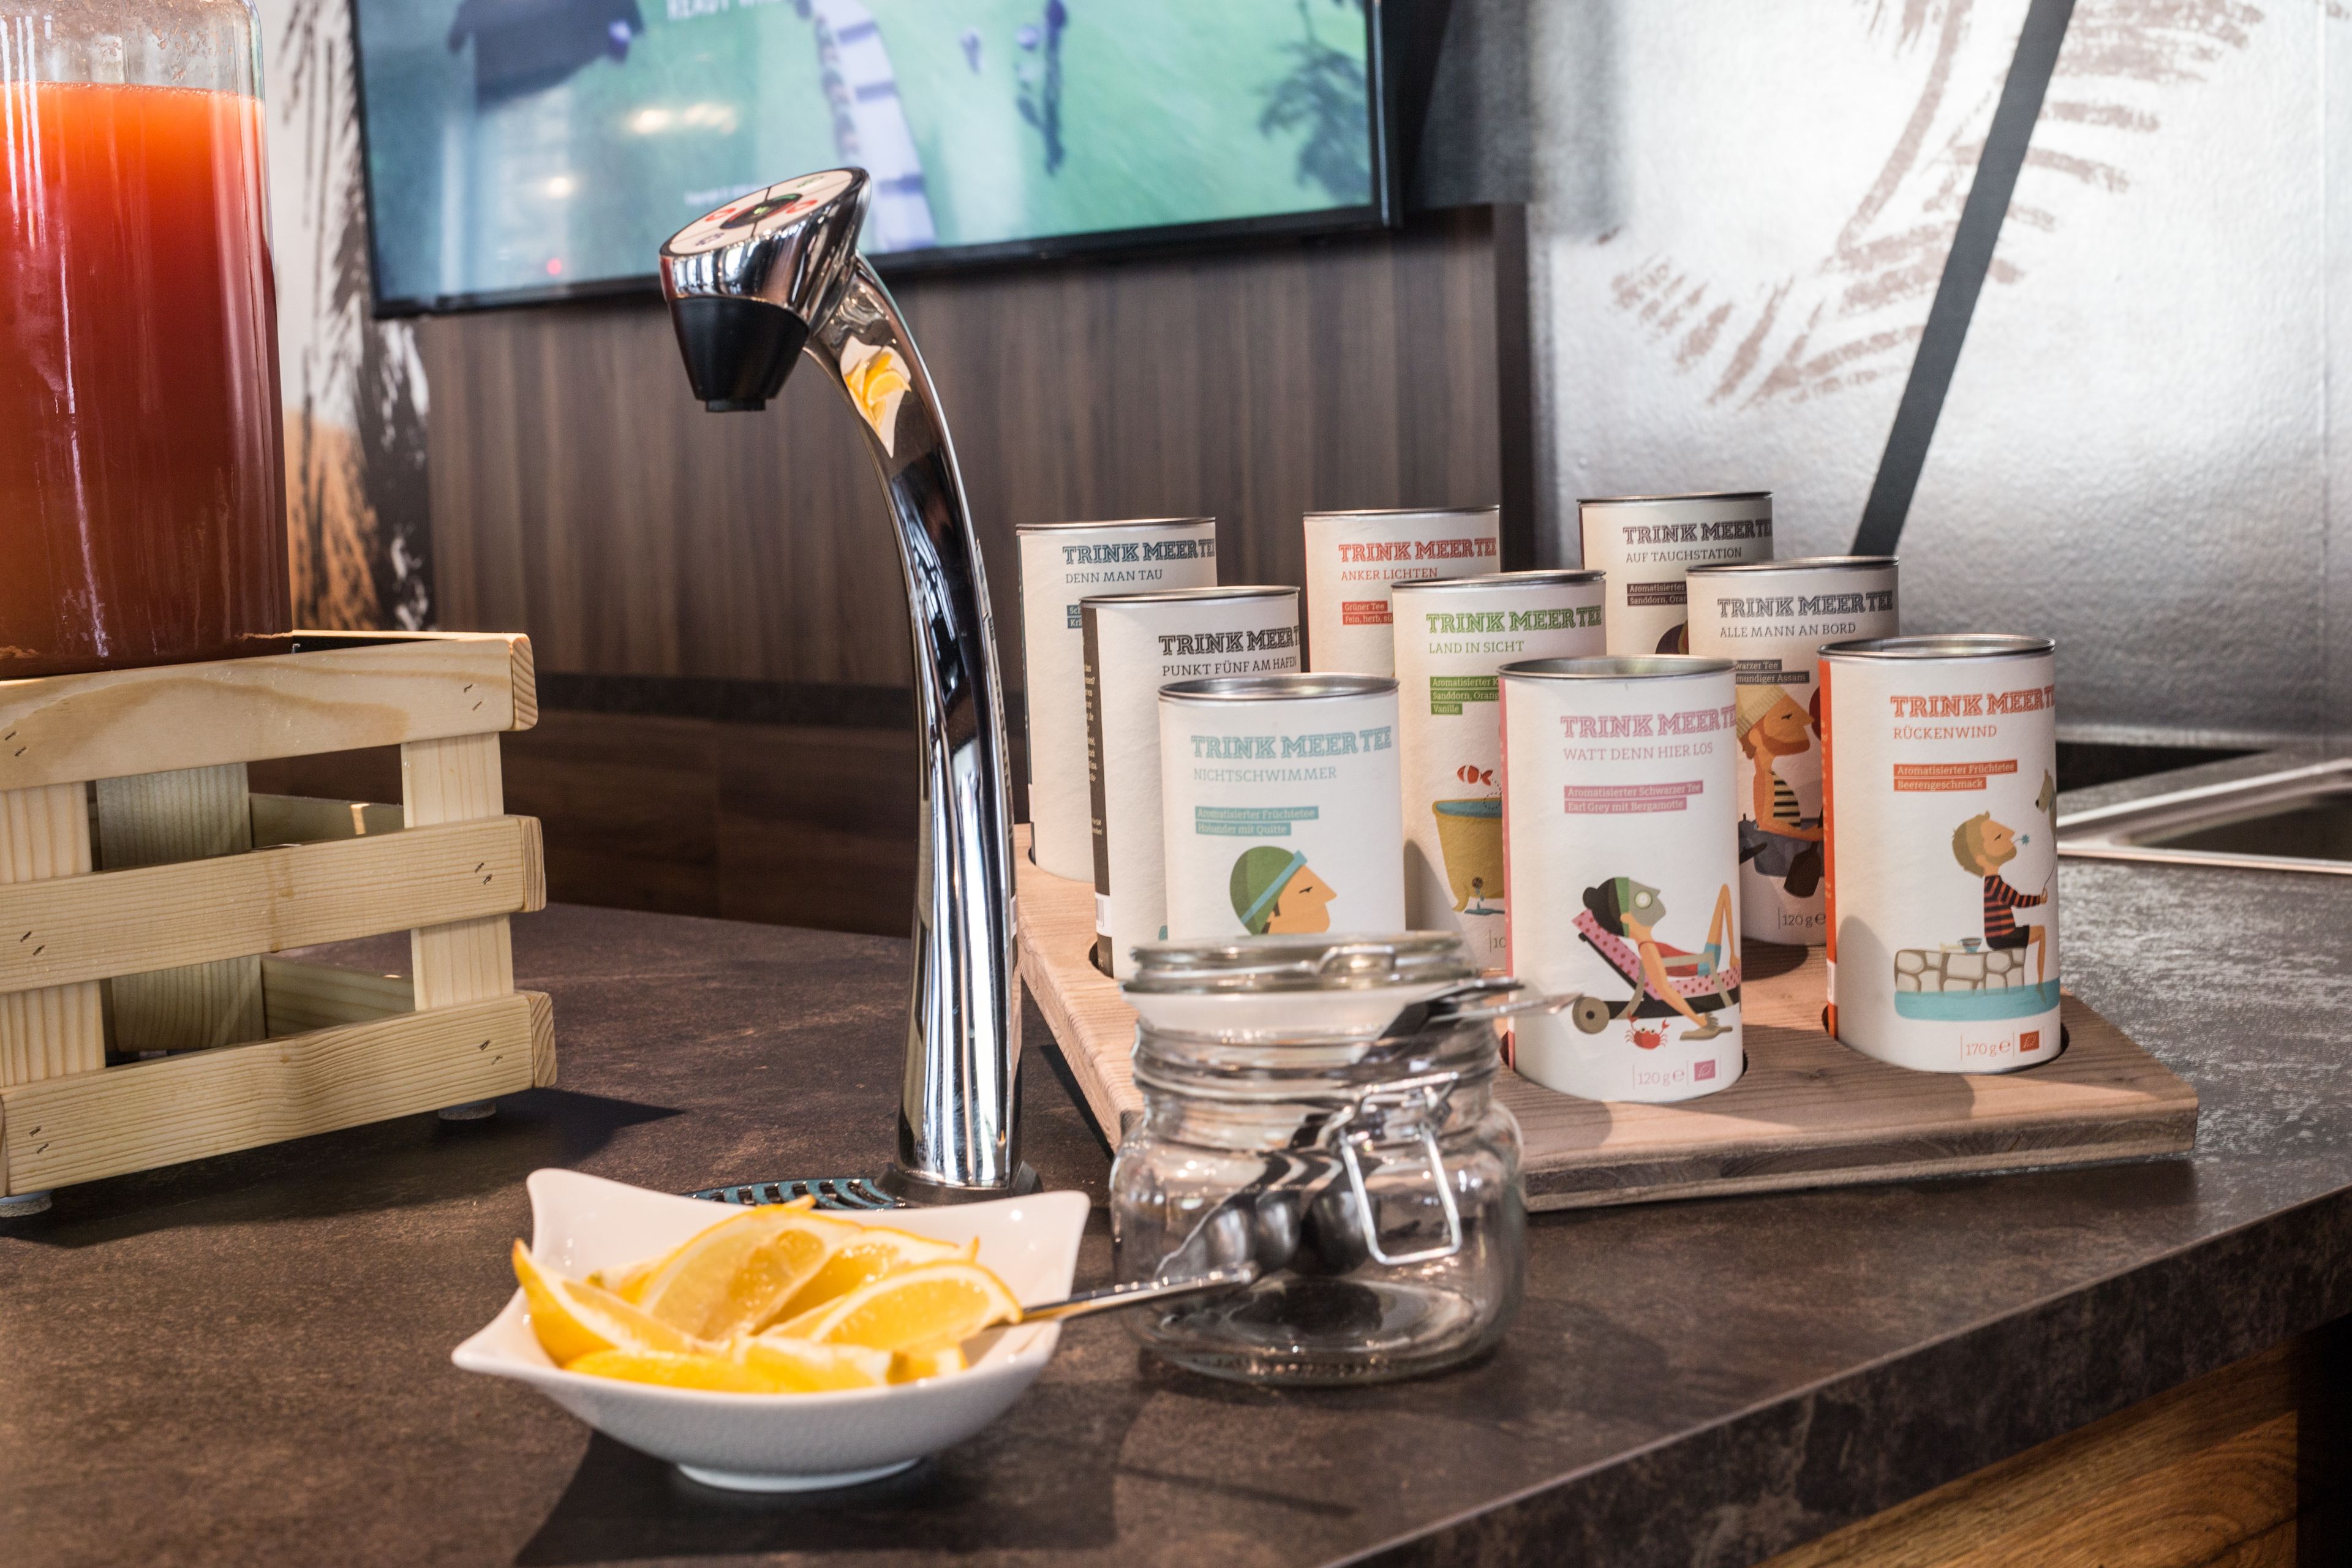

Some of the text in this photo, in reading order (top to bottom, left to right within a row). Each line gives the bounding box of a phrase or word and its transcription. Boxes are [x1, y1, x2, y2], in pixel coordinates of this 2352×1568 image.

[1623, 522, 1697, 545] TRINK
[1700, 519, 1755, 543] MEER
[1062, 543, 1139, 565] TRINK
[1142, 540, 1198, 561] MEER
[1338, 541, 1412, 563] TRINK
[1414, 538, 1475, 560] MEER
[1626, 546, 1742, 564] AUF TAUCHSTATION
[1065, 569, 1163, 584] DENN MAN TAU
[1341, 567, 1438, 581] ANKER LICHTEN
[1629, 584, 1685, 593] Aromatisierter
[1344, 602, 1385, 611] Grüner Tee
[1717, 596, 1795, 619] TRINK
[1798, 592, 1866, 617] MEER
[1426, 611, 1506, 634] TRINK
[1509, 609, 1576, 632] MEER
[1720, 622, 1856, 638] ALLE MANN AN BORD
[1158, 631, 1244, 656] TRINK
[1246, 627, 1294, 651] MEER
[1429, 640, 1524, 654] LAND IN SICHT
[1163, 656, 1297, 677] PUNKT FÜNF AM HAFEN
[1433, 677, 1490, 687] Aromatisierter
[1736, 674, 1806, 684] mundiger Assam
[1433, 704, 1460, 714] Vanille
[1890, 693, 1983, 718] TRINK
[1986, 688, 2045, 715] MEER
[1560, 714, 1653, 739] TRINK
[1657, 708, 1721, 736] MEER
[1893, 724, 1997, 740] RÜCKENWIND
[1191, 725, 1392, 759] TRINK MEER TEE
[1563, 742, 1713, 761] WATT DENN HIER LOS
[1193, 766, 1337, 783] NICHTSCHWIMMER
[1898, 763, 2015, 776] Aromatisierter Früchtetee
[1567, 784, 1702, 797] Aromatisierter Schwarzer Tee
[1898, 778, 1983, 791] Beerengeschmack
[1568, 799, 1684, 813] Earl Grey mit Bergamotte
[1197, 809, 1314, 819] Aromatisierter Früchtetee
[1198, 824, 1287, 835] Holunder mit Quitte
[1493, 937, 1506, 948] 10
